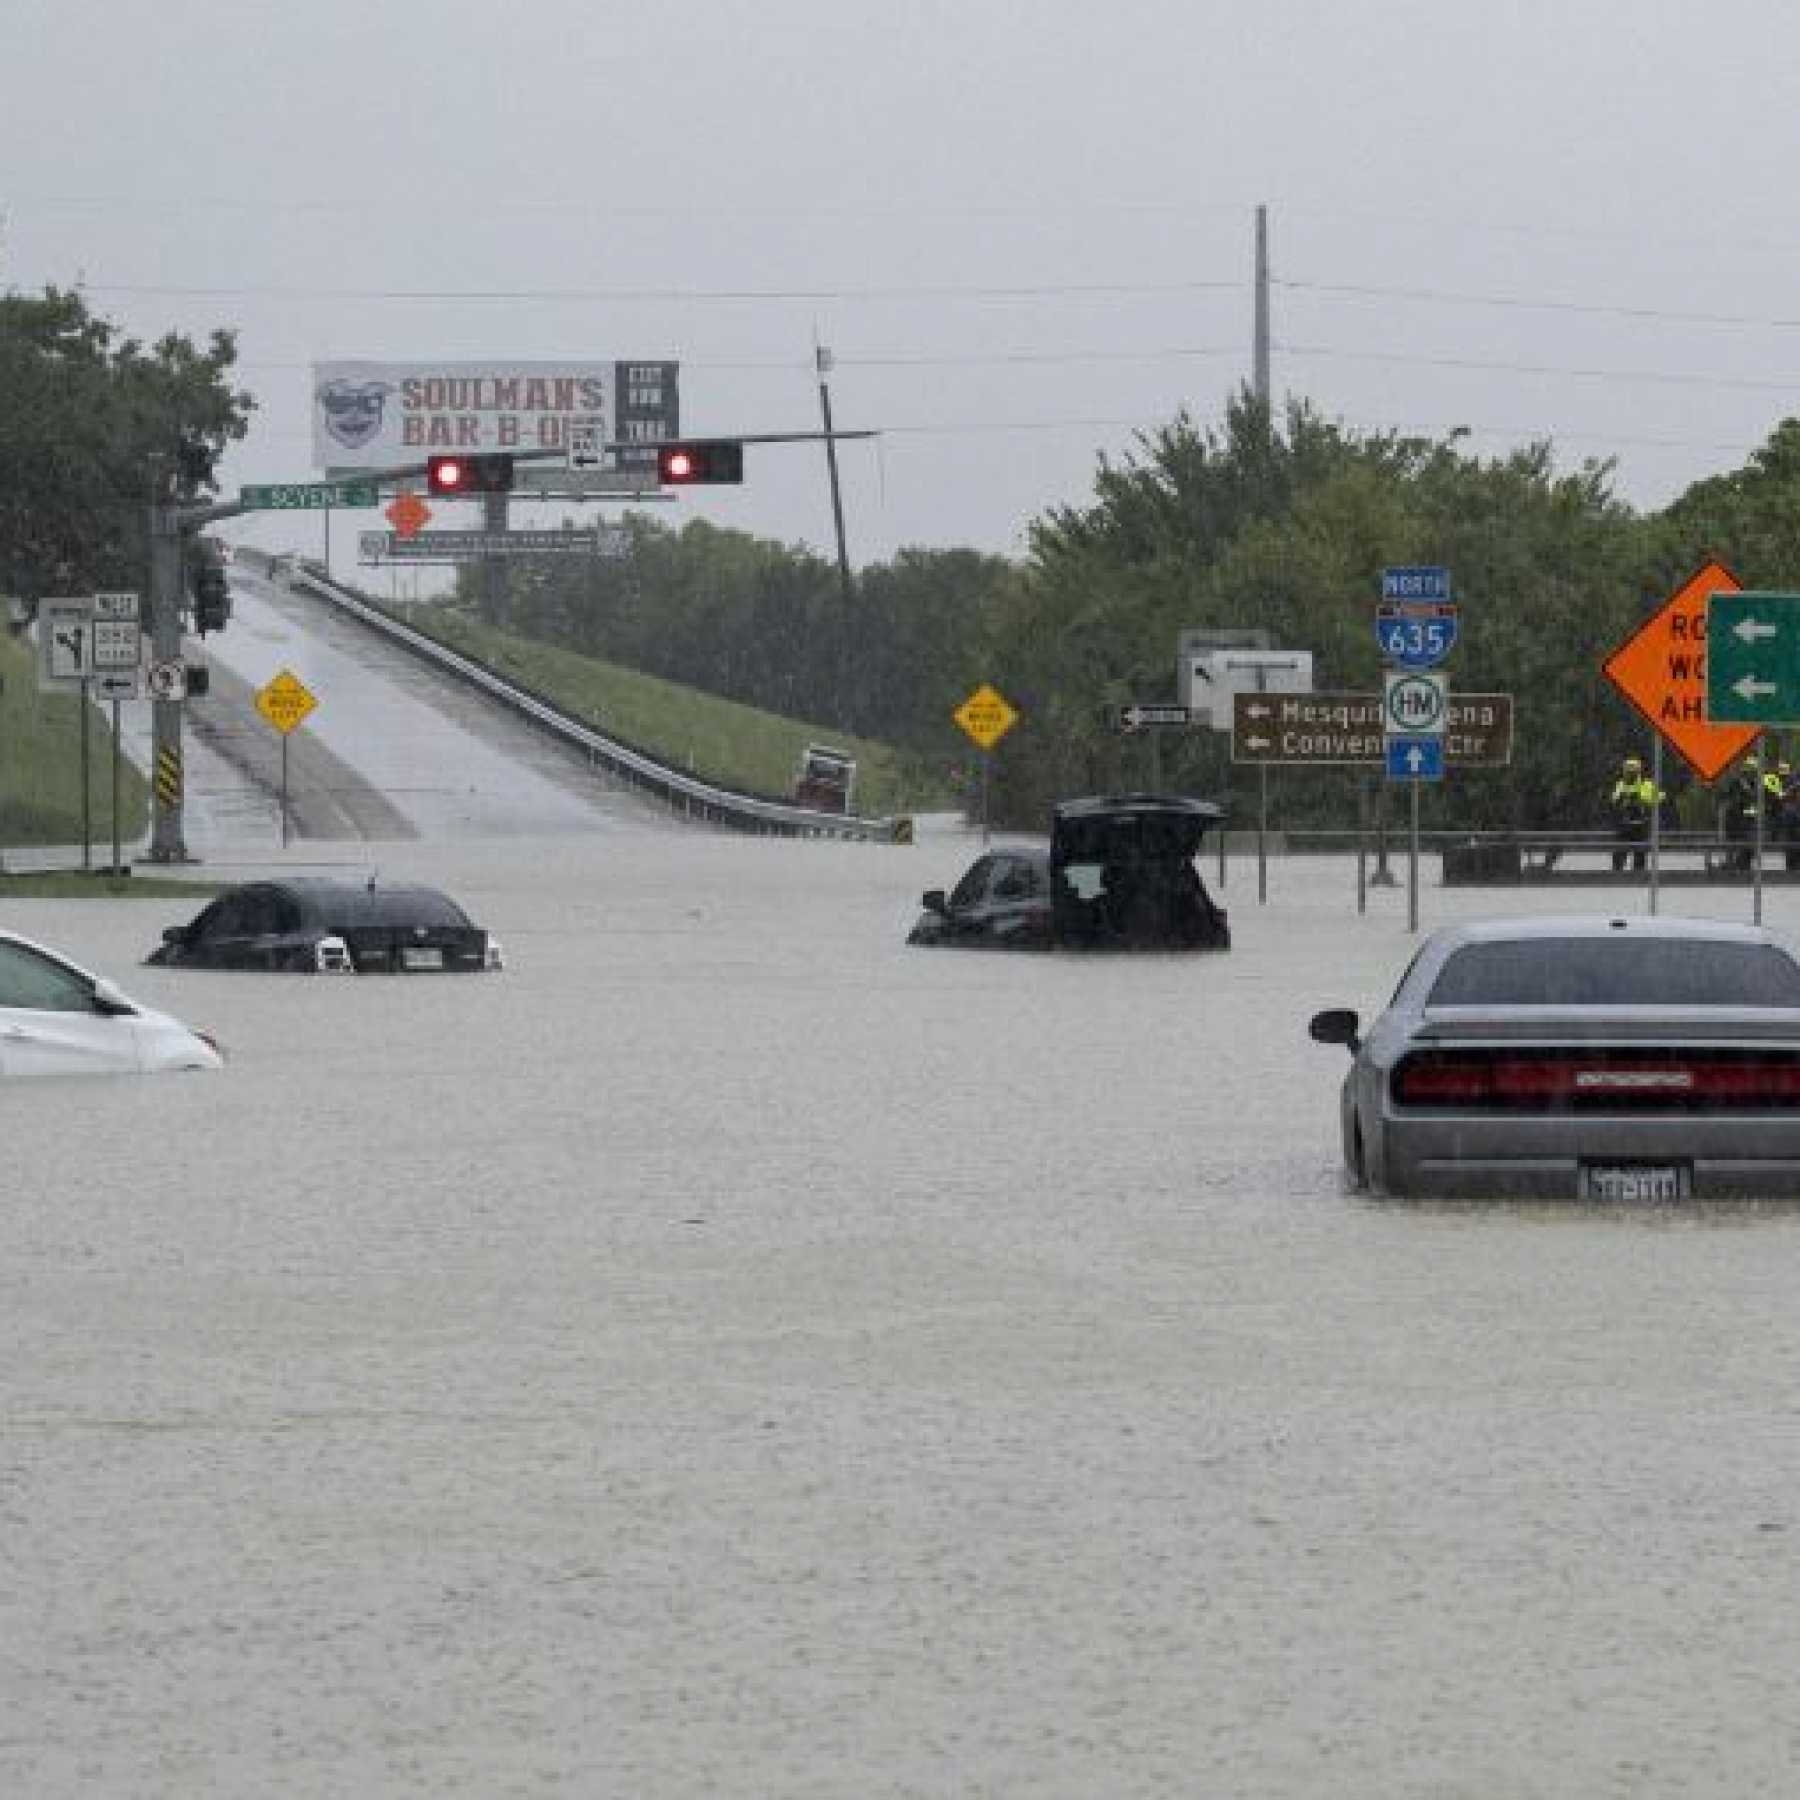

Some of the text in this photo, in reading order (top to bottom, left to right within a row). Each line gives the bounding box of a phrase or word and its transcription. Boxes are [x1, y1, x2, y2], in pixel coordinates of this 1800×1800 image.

[402, 377, 603, 411] SOULMAN'S
[402, 415, 604, 447] BAR-B-Q
[271, 487, 343, 508] SCYENE
[1386, 574, 1444, 596] NORTH
[1388, 624, 1445, 655] 635
[1671, 615, 1706, 641] RO
[1668, 653, 1705, 680] WO
[1282, 699, 1493, 730] Mesquit ena
[1282, 731, 1487, 754] Conven Ctr
